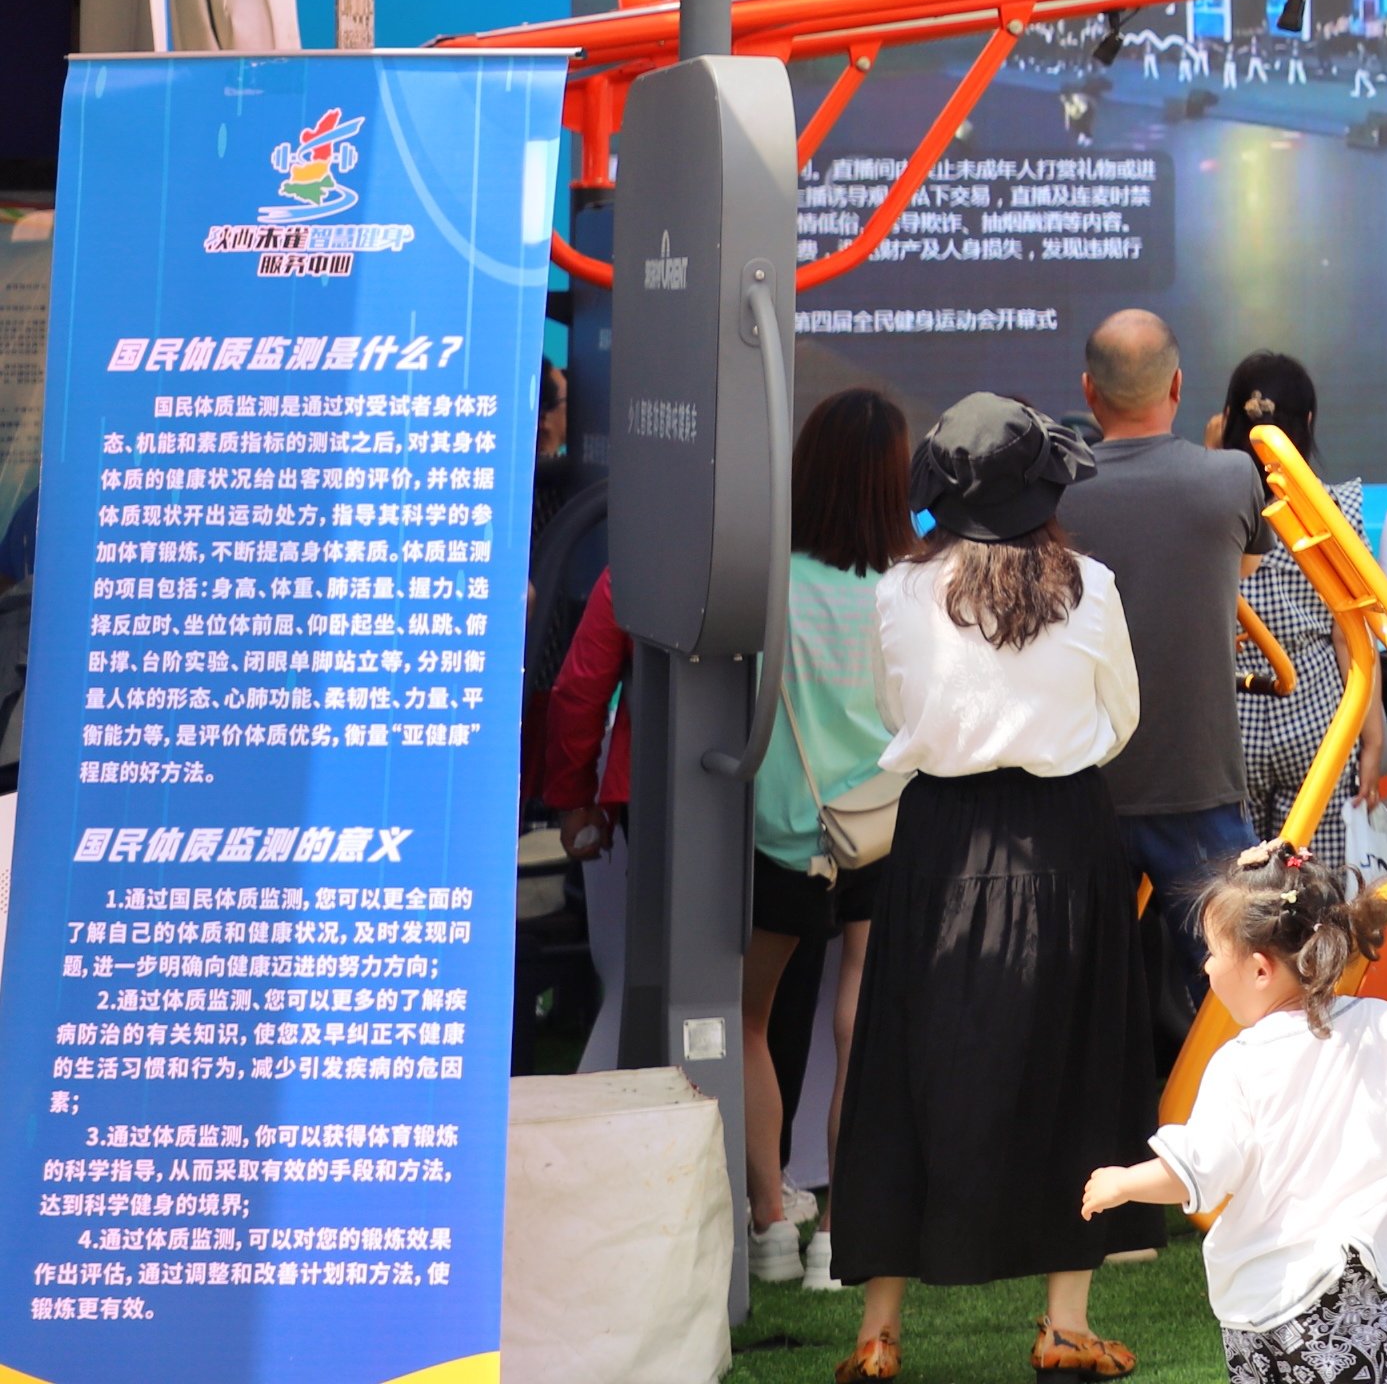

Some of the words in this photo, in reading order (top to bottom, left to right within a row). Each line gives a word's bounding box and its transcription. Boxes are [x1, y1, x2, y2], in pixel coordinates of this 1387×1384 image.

[154, 394, 498, 418] 国民体质监测是通过对受试者身体形
[79, 760, 214, 784] 程度的好方法。
[73, 827, 413, 864] 国民体质监测的意义
[30, 1297, 155, 1321] 锻炼更有效。
